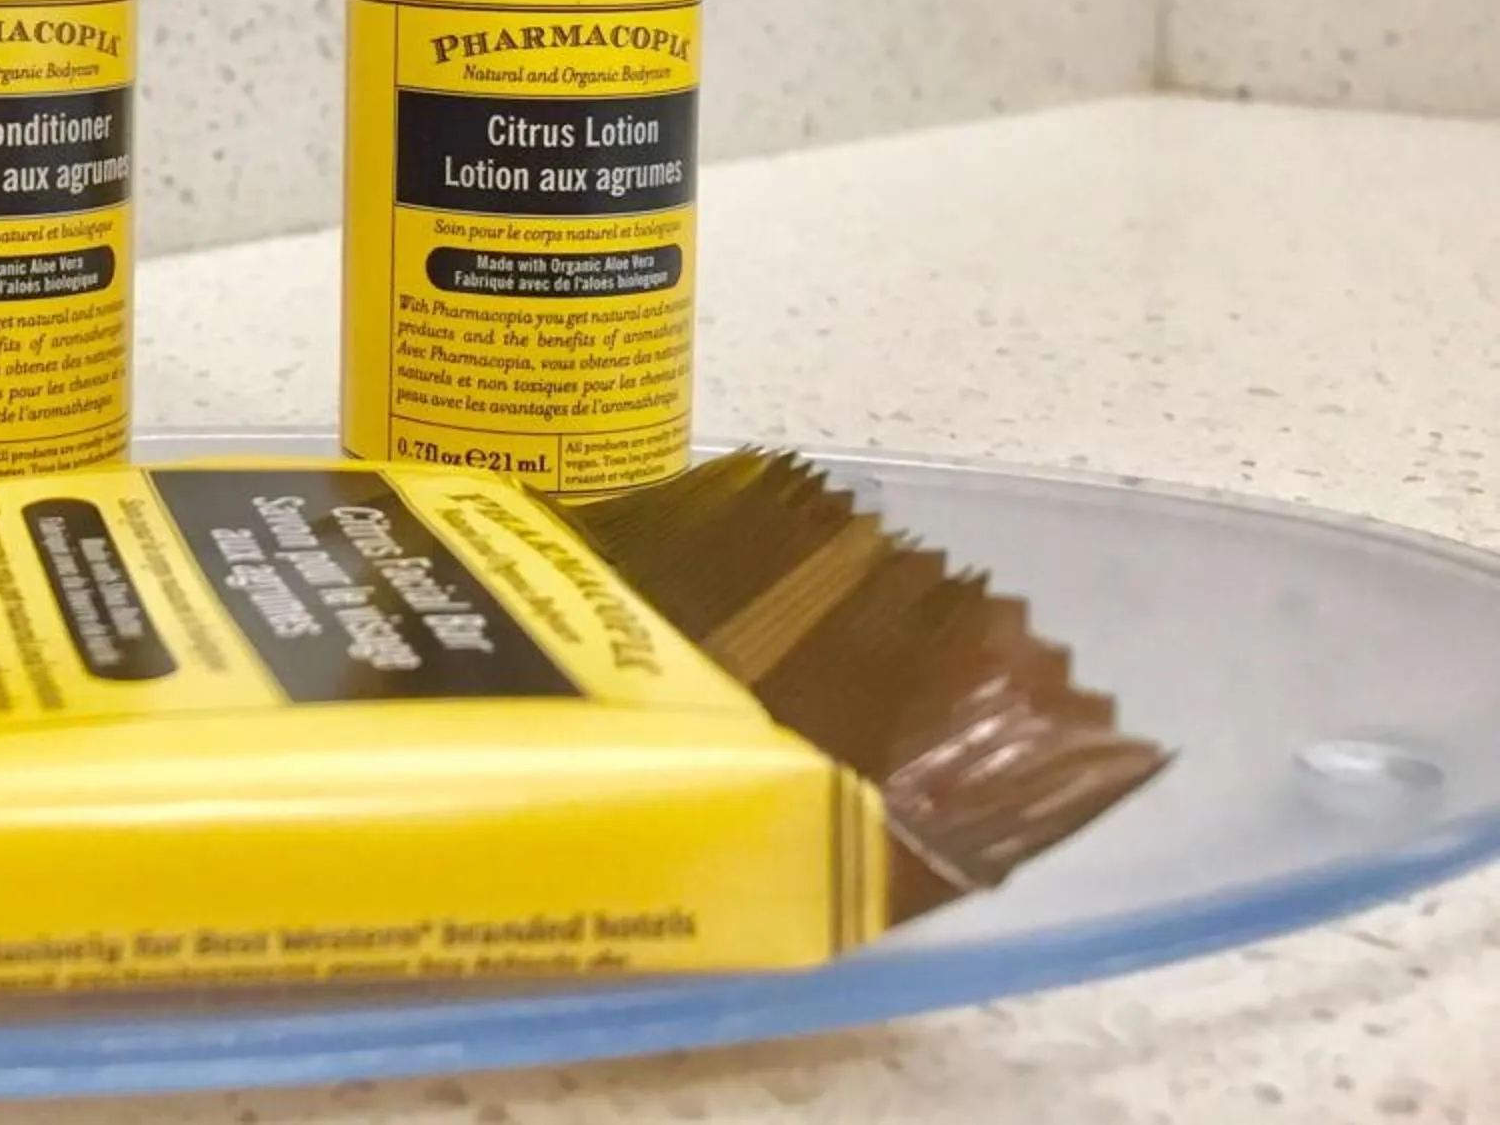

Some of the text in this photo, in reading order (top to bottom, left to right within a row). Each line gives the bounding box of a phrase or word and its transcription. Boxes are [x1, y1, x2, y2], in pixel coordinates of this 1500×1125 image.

[430, 23, 691, 65] PHARMACOPIA
[463, 64, 524, 83] Natural
[528, 66, 559, 83] and
[562, 67, 618, 87] Organic
[487, 113, 659, 148] Citrus Lotion
[2, 167, 50, 193] aux
[55, 154, 131, 194] agrumes
[444, 156, 683, 197] Lotion aux agrumes
[30, 257, 57, 274] Aloe
[59, 255, 84, 271] Vera
[477, 254, 514, 272] Made
[517, 257, 547, 273] with
[550, 257, 602, 277] Organic
[604, 255, 630, 271] Aloe
